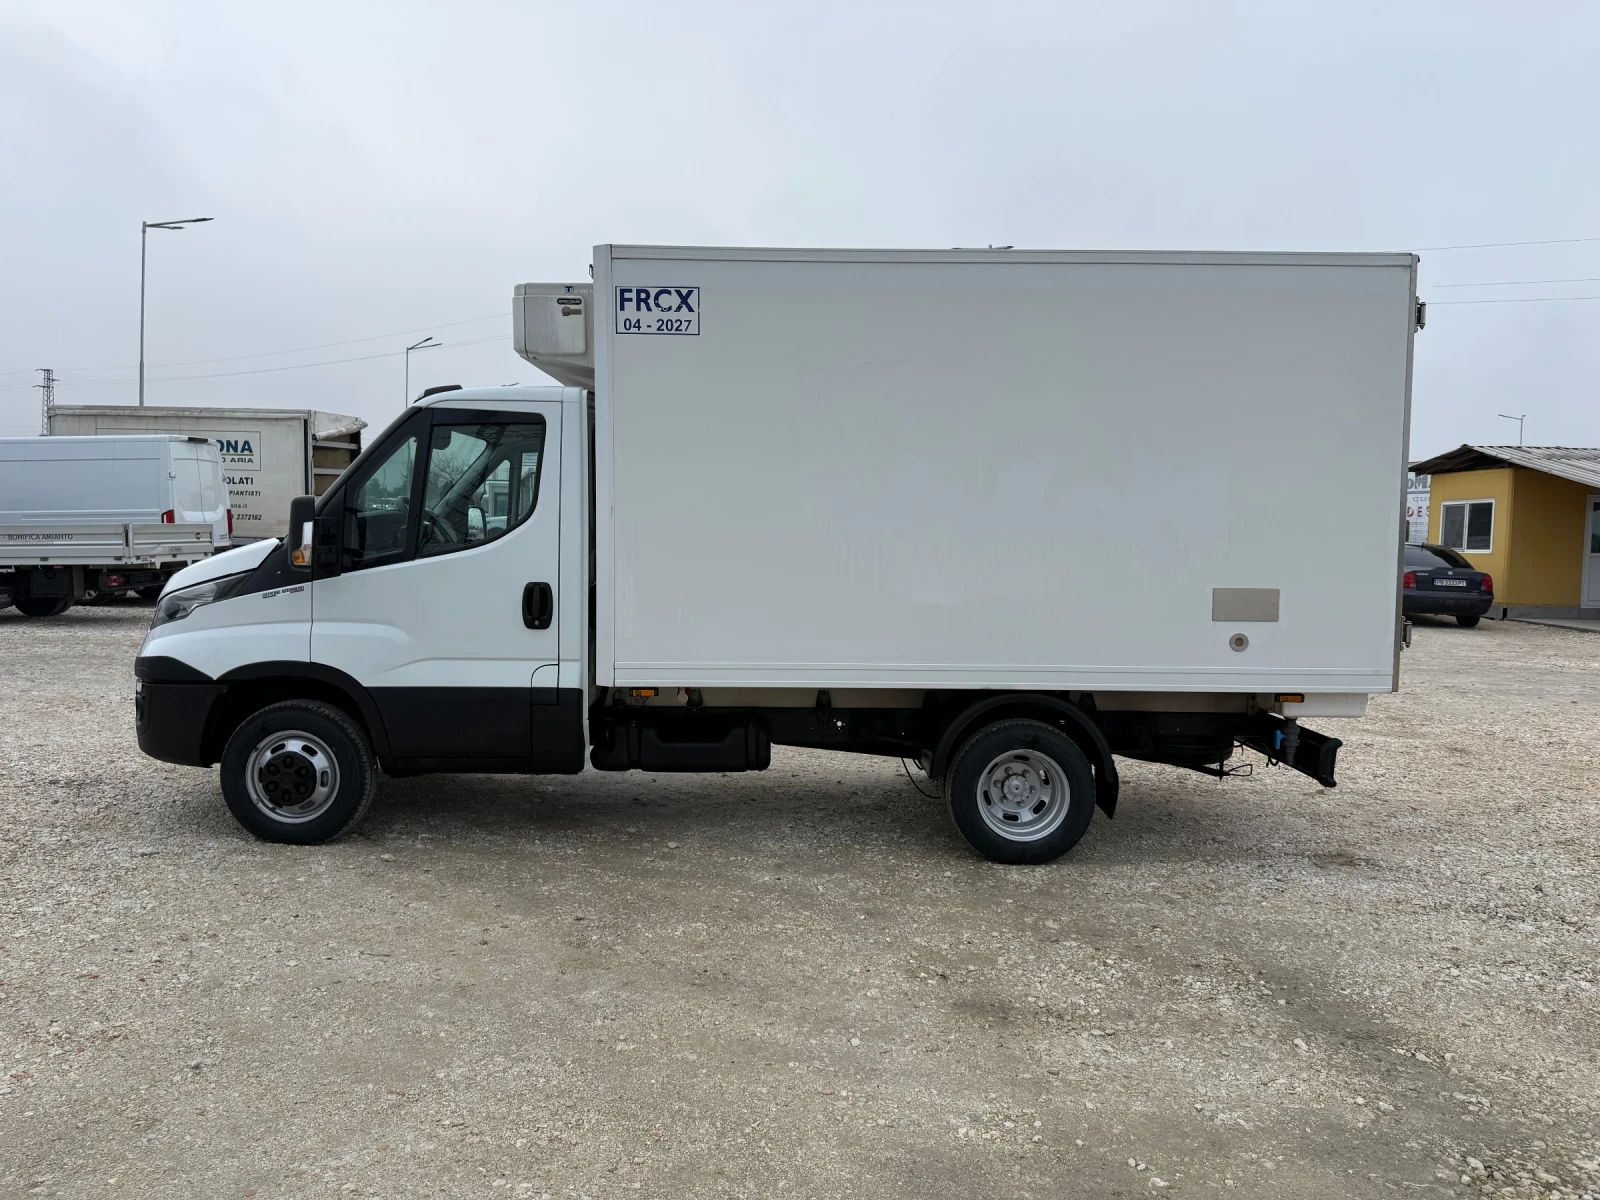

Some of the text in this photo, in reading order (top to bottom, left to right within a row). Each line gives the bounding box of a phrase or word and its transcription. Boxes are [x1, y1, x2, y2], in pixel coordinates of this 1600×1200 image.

[619, 288, 695, 312] FRCX
[623, 318, 641, 331] 04
[656, 318, 692, 332] 2027
